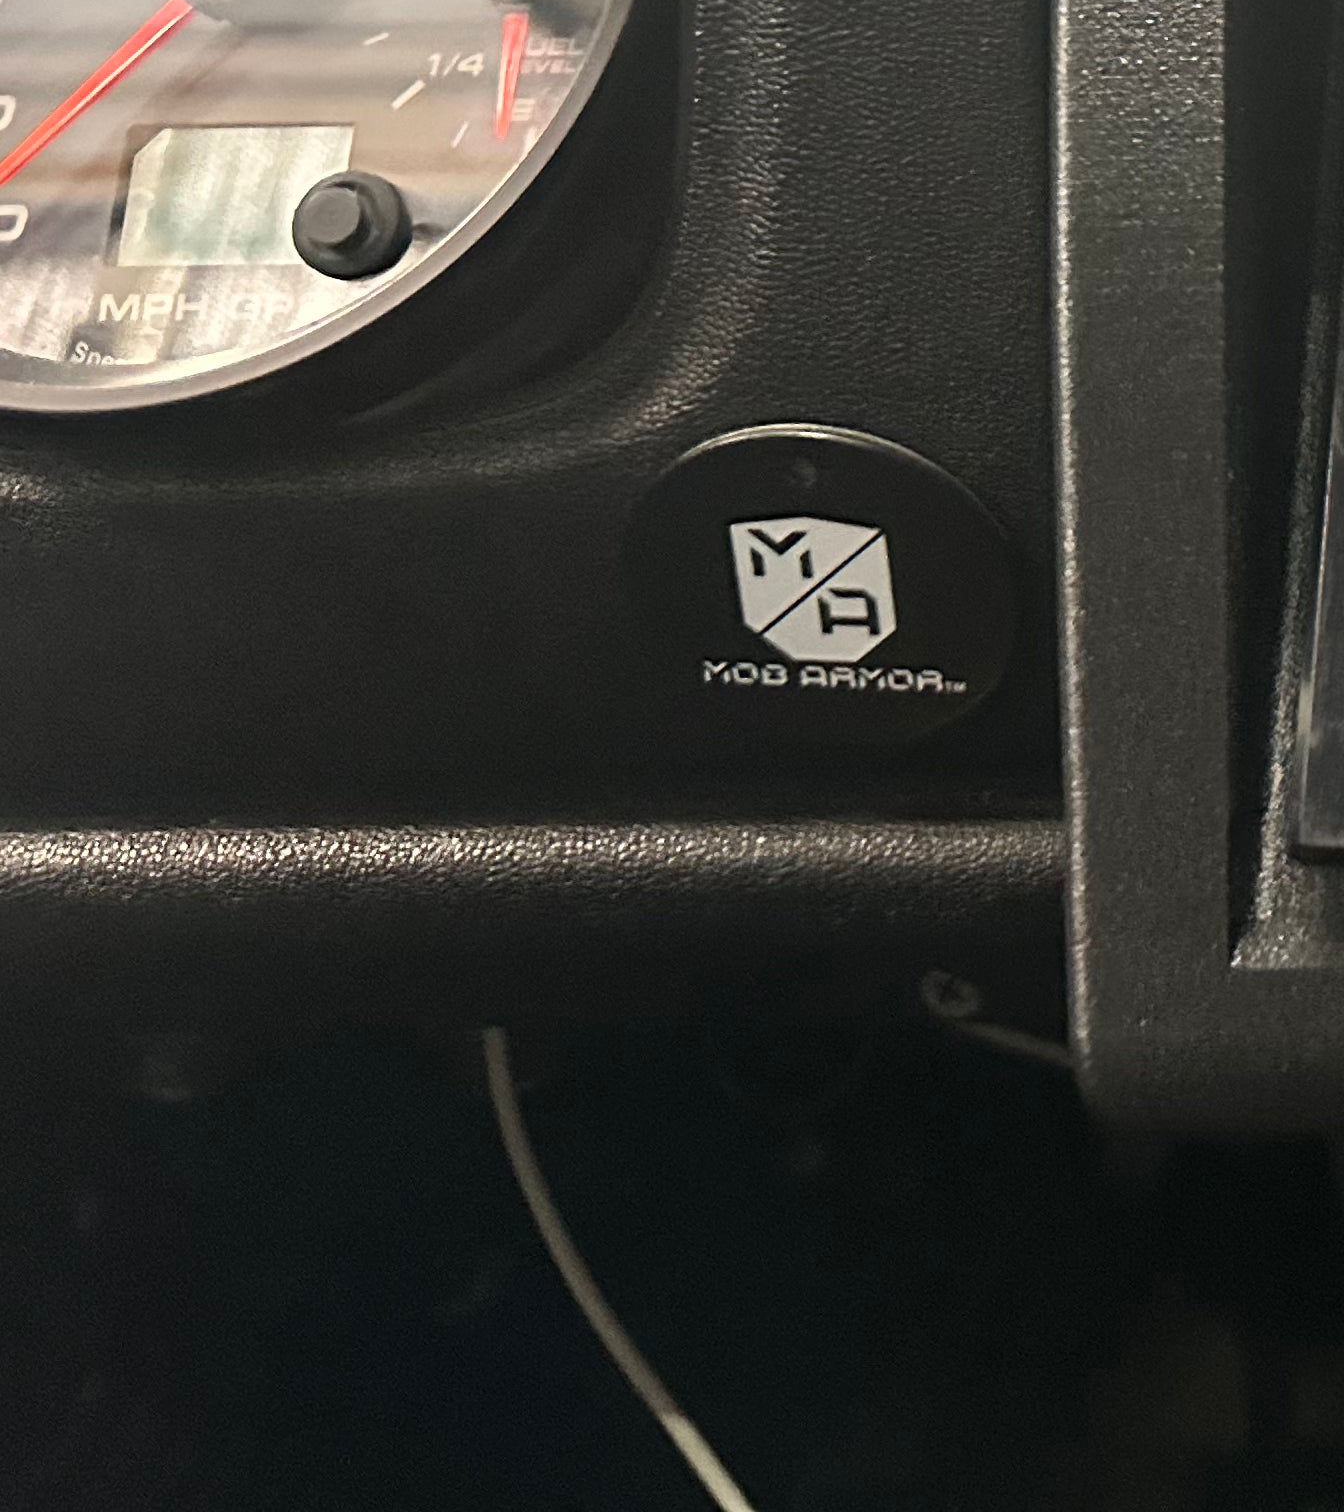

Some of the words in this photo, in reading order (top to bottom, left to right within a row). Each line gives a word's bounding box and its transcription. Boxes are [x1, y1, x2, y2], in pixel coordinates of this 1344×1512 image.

[525, 37, 584, 56] UEL
[427, 53, 485, 77] 1/4
[98, 292, 209, 322] MPH
[703, 660, 788, 686] MOB
[800, 666, 943, 692] ARMOR
